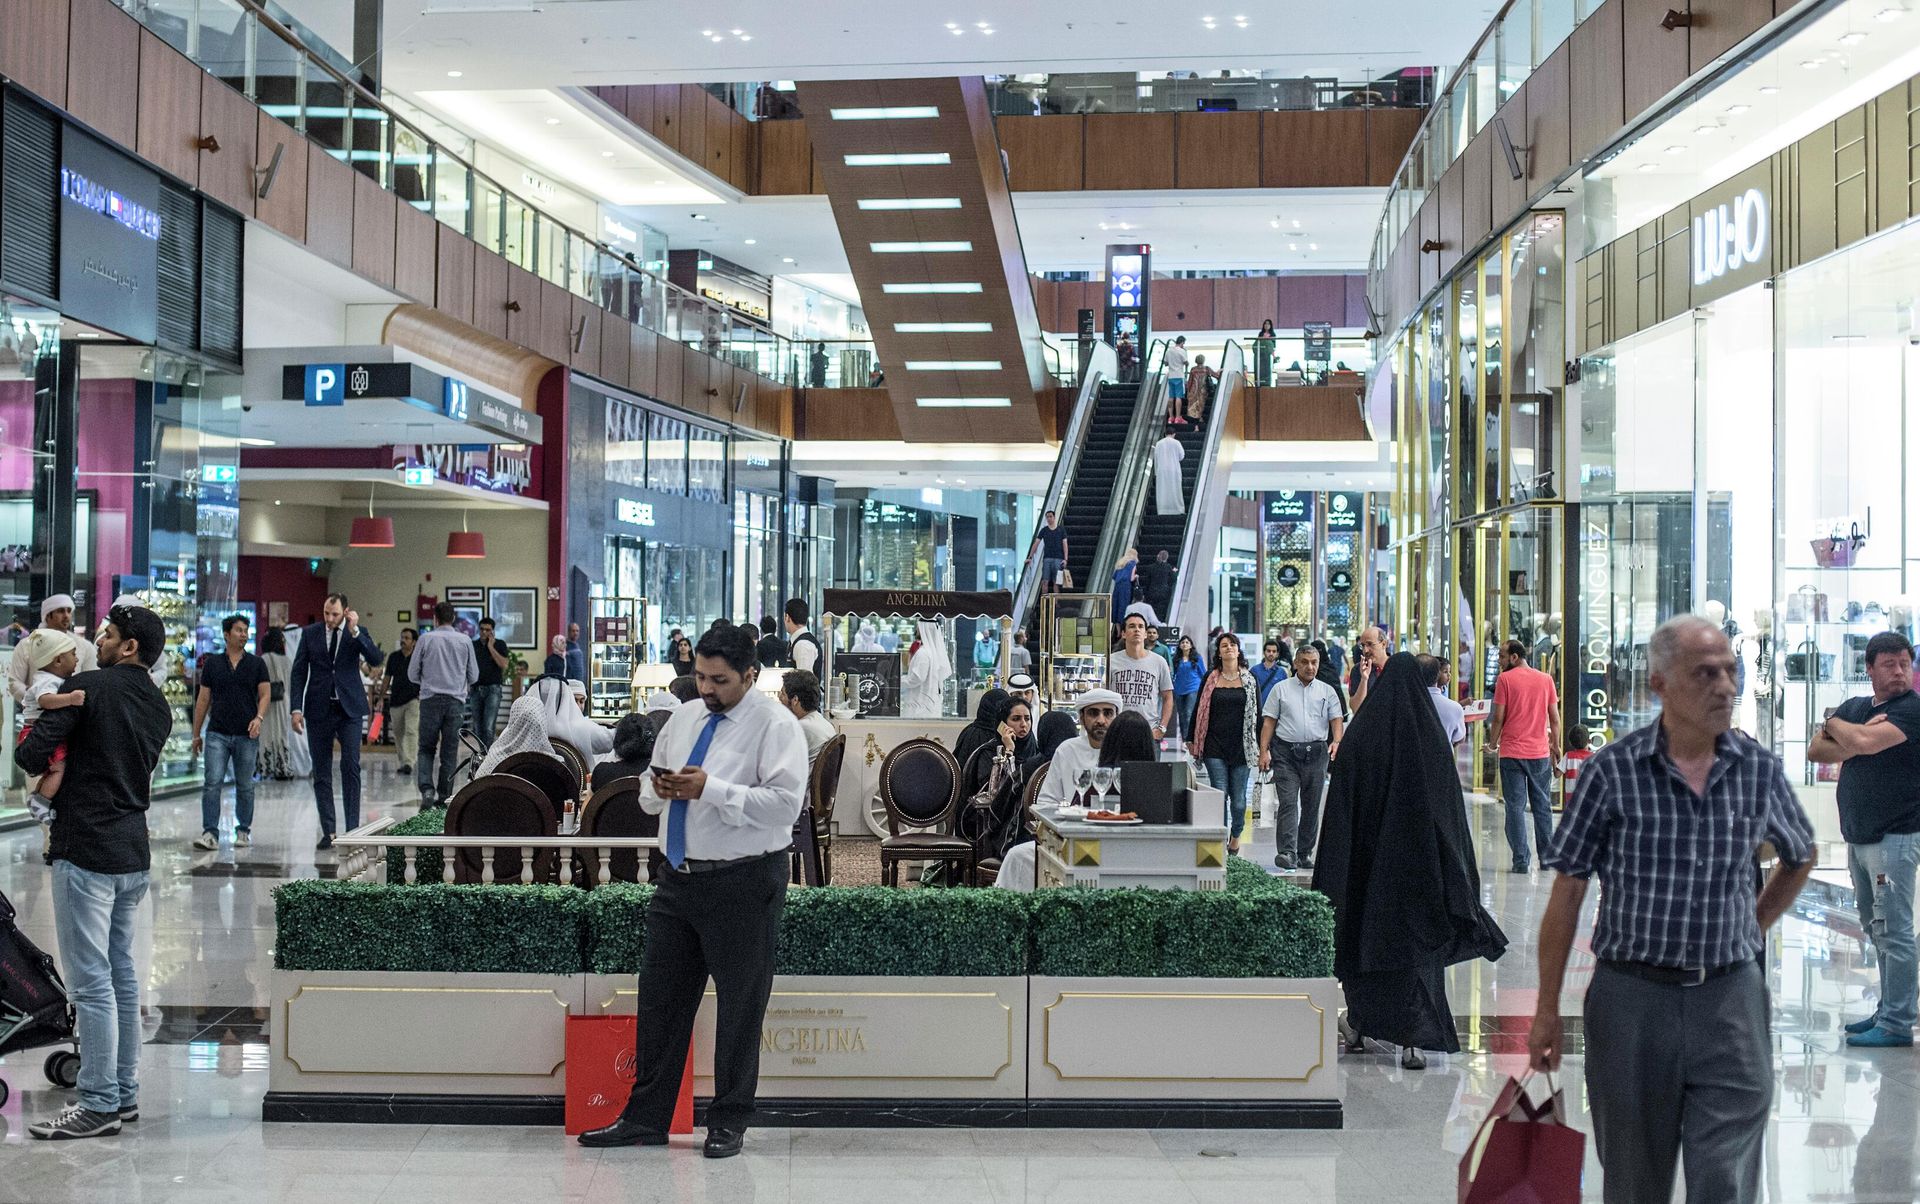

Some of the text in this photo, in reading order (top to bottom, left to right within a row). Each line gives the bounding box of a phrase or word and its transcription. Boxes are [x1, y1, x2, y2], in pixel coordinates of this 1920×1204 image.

[316, 369, 336, 401] P
[886, 593, 947, 606] ANGELINA
[1587, 522, 1609, 674] DOMINGUEZ
[1115, 683, 1154, 700] HILFIGER
[1130, 696, 1147, 705] CITY
[760, 1026, 865, 1053] NGELINA
